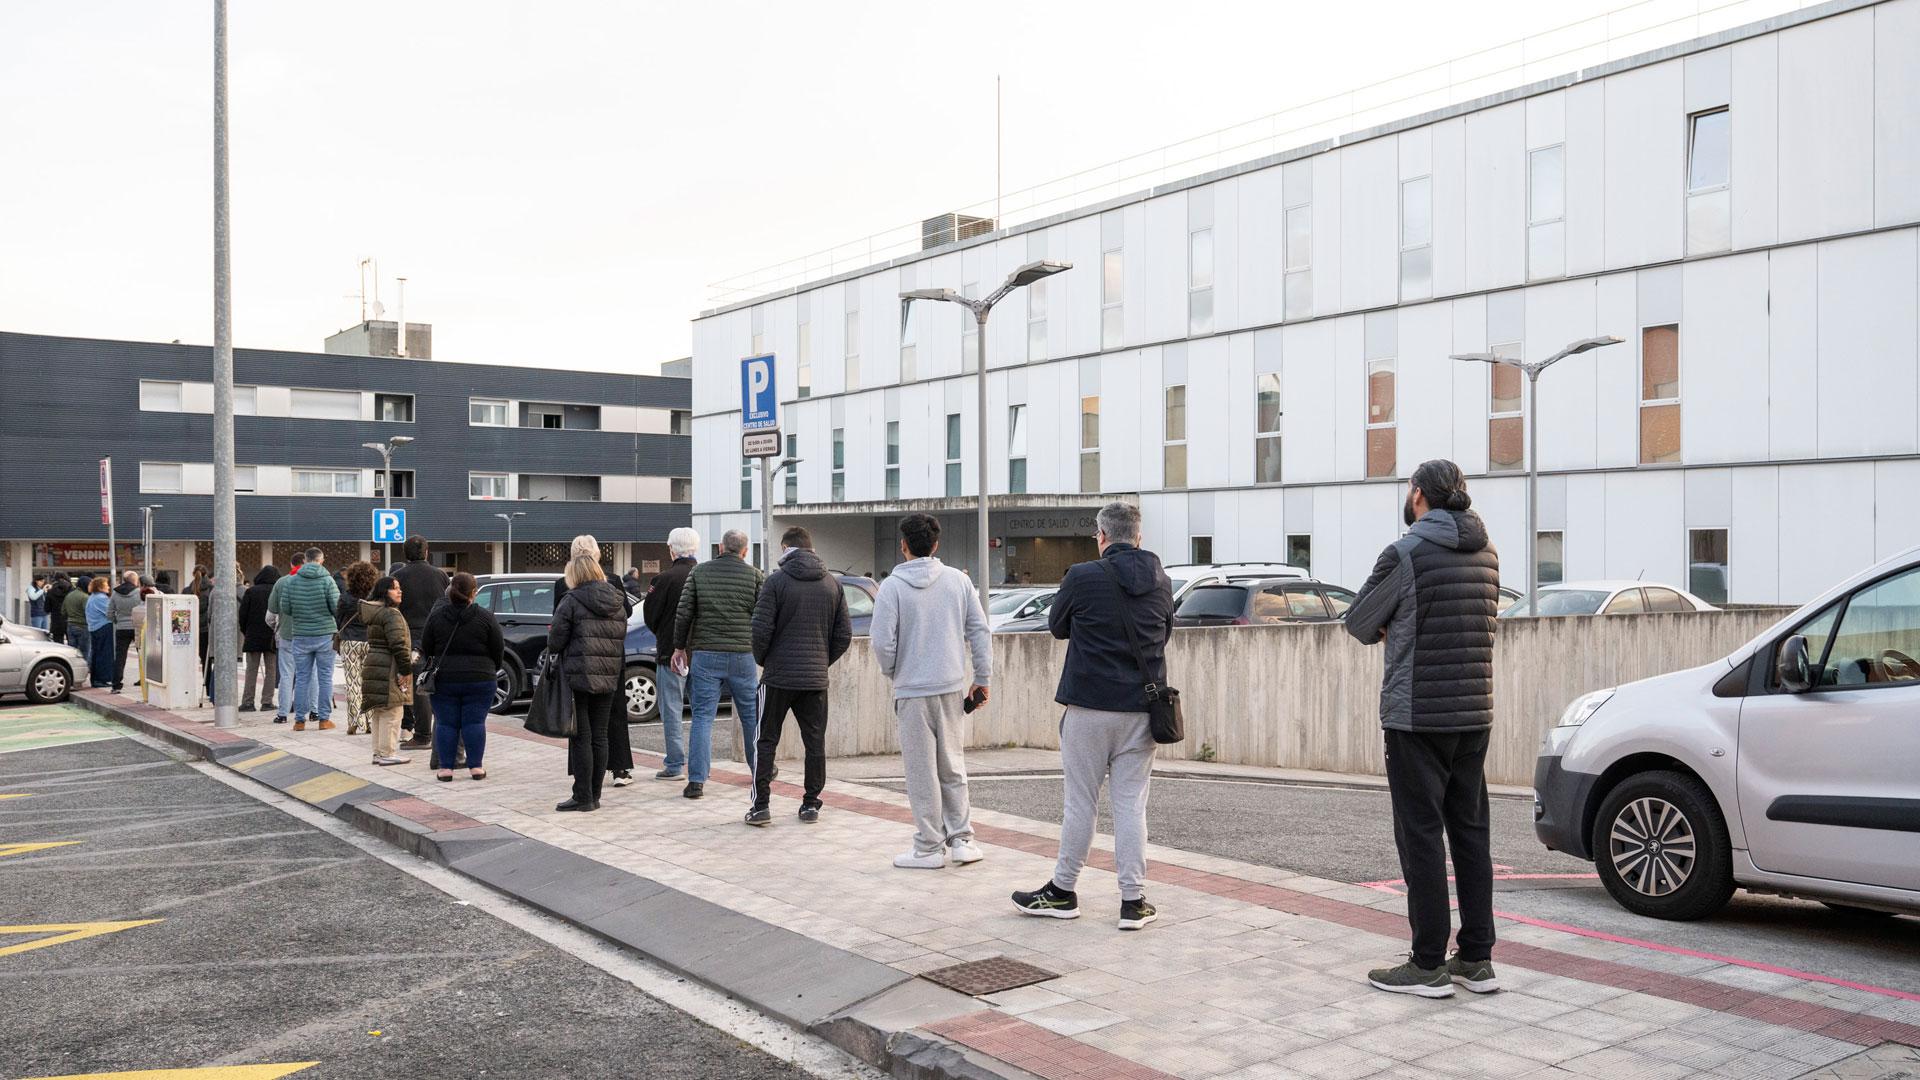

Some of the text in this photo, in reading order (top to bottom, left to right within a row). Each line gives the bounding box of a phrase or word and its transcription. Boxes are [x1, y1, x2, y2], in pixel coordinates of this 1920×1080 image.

[749, 361, 769, 412] P
[380, 512, 400, 538] P
[1010, 519, 1034, 529] CENTRO
[1037, 519, 1046, 528] DE
[1049, 518, 1069, 528] SALUD
[64, 550, 112, 560] VENDIN
